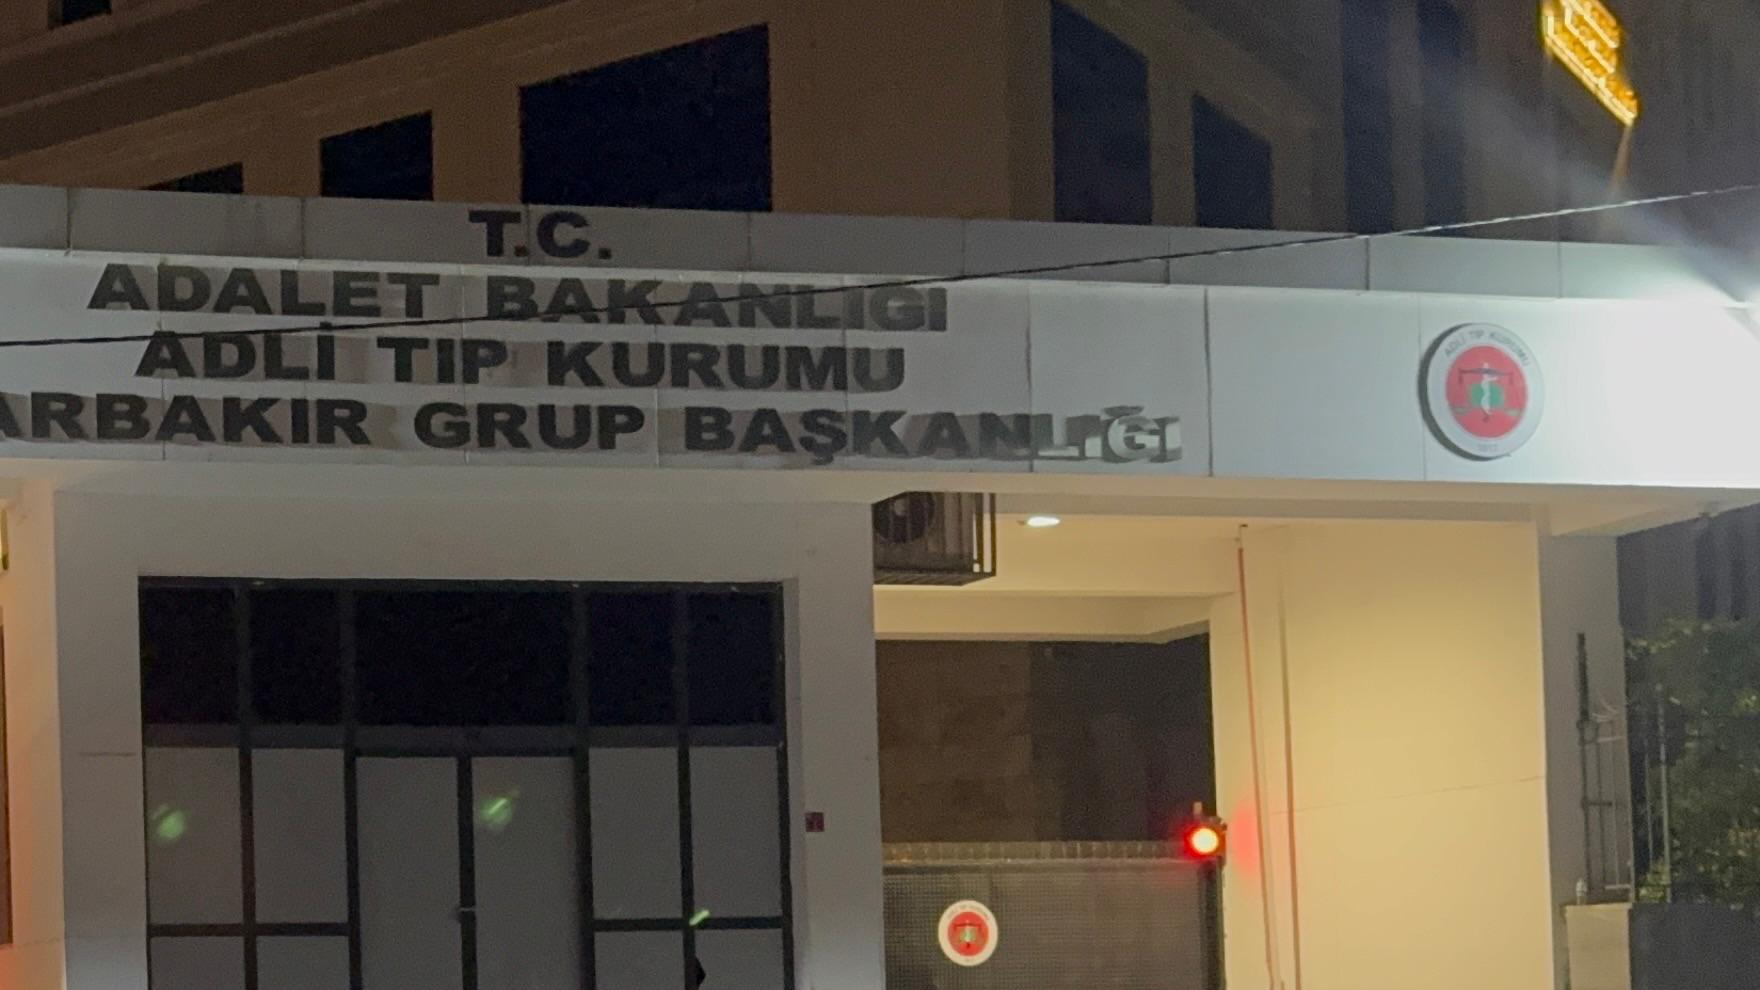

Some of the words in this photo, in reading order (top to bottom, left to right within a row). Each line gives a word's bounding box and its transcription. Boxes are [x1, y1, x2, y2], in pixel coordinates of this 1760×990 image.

[468, 209, 612, 260] T.C.
[87, 262, 440, 319] ADALET
[135, 322, 336, 381] ADLİ
[377, 336, 510, 385] TIP
[546, 340, 906, 393] KURUMU
[413, 401, 646, 450] GRUP
[683, 404, 1183, 467] BAŞKANLIĞI
